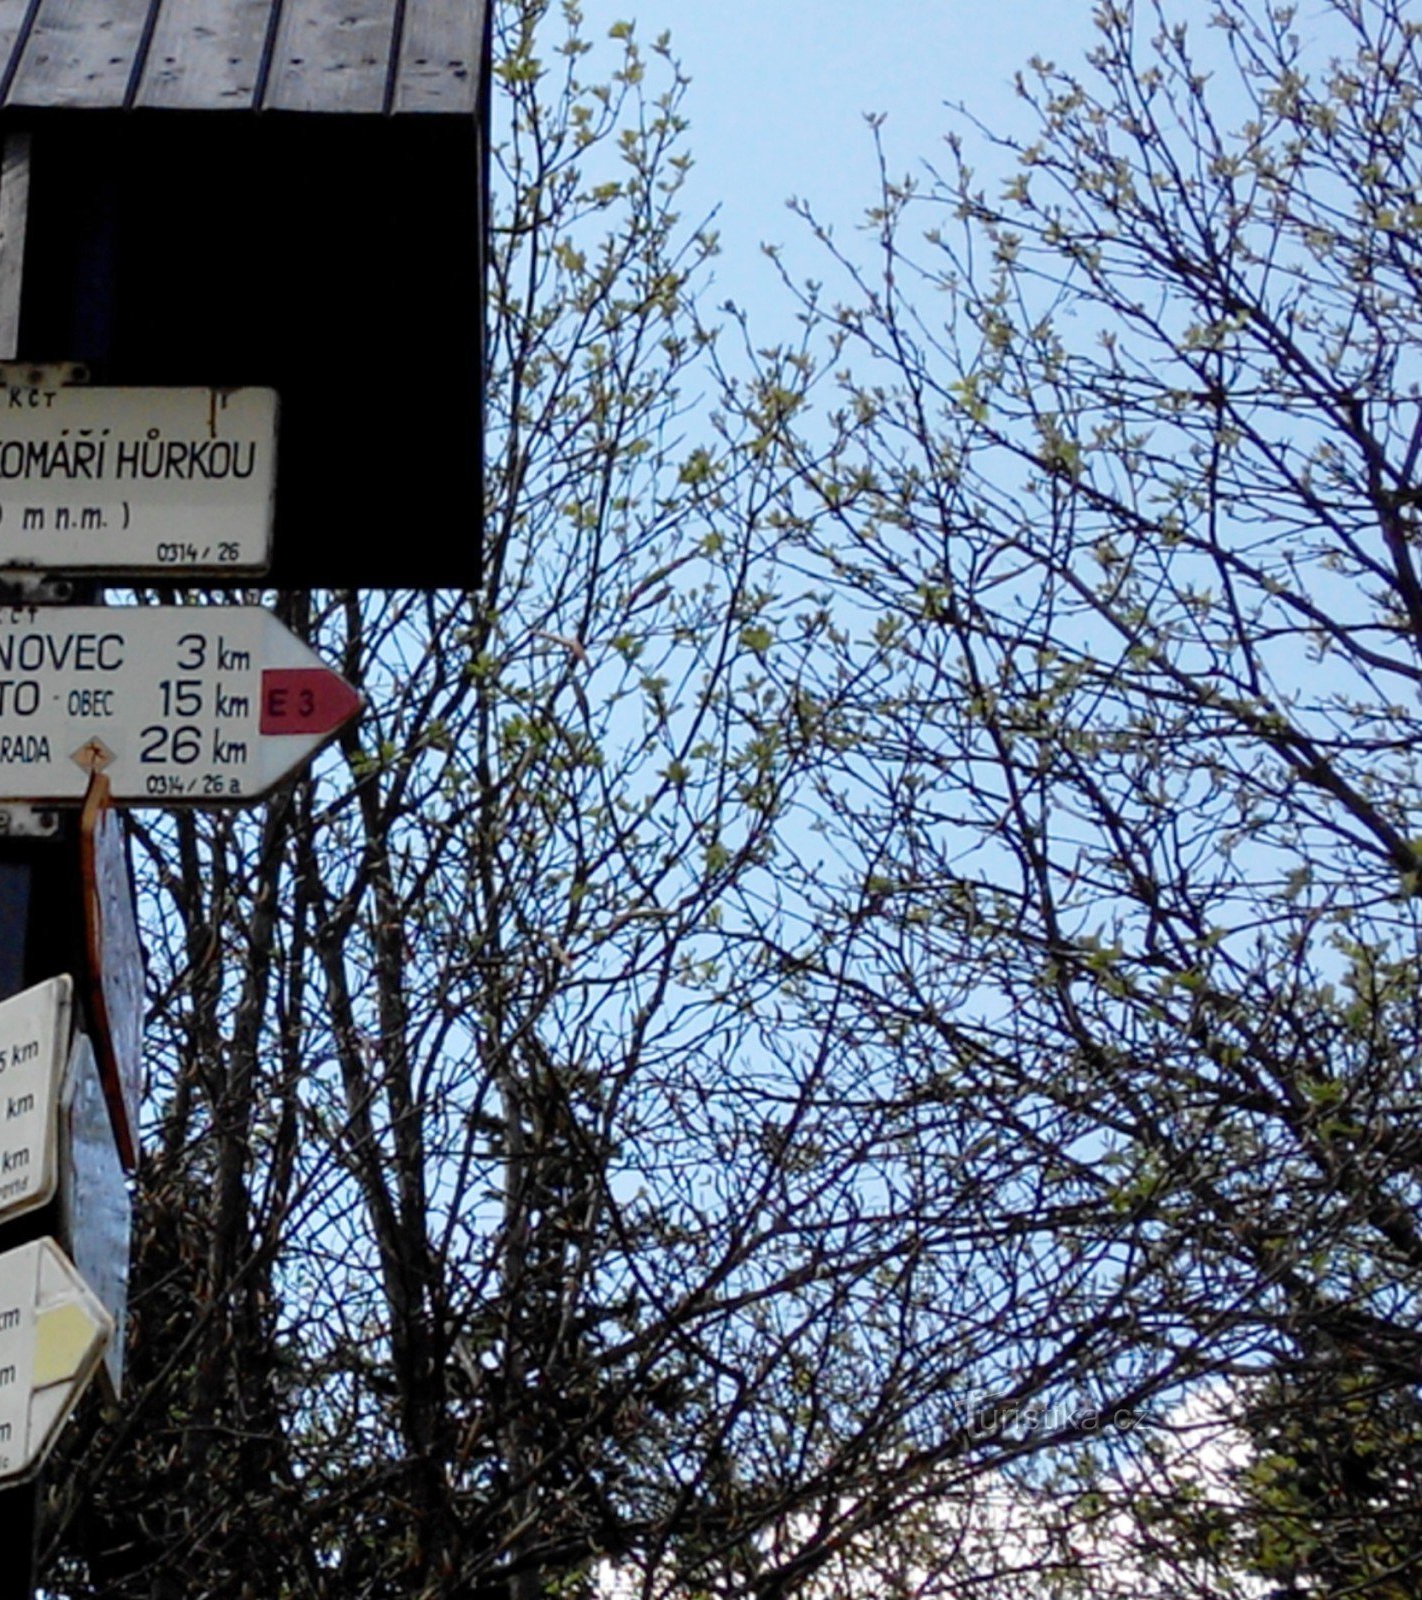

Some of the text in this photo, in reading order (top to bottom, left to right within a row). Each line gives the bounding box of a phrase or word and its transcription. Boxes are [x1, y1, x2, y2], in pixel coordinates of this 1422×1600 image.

[116, 428, 256, 480] HŮRKOU
[177, 634, 206, 672] 3
[217, 637, 251, 671] km
[67, 690, 114, 716] OBEC
[159, 681, 203, 717] 15
[215, 682, 249, 717] km
[140, 727, 200, 764] 26
[212, 729, 248, 764] km
[11, 1038, 40, 1069] km
[6, 1091, 35, 1122] km
[1, 1146, 30, 1177] km
